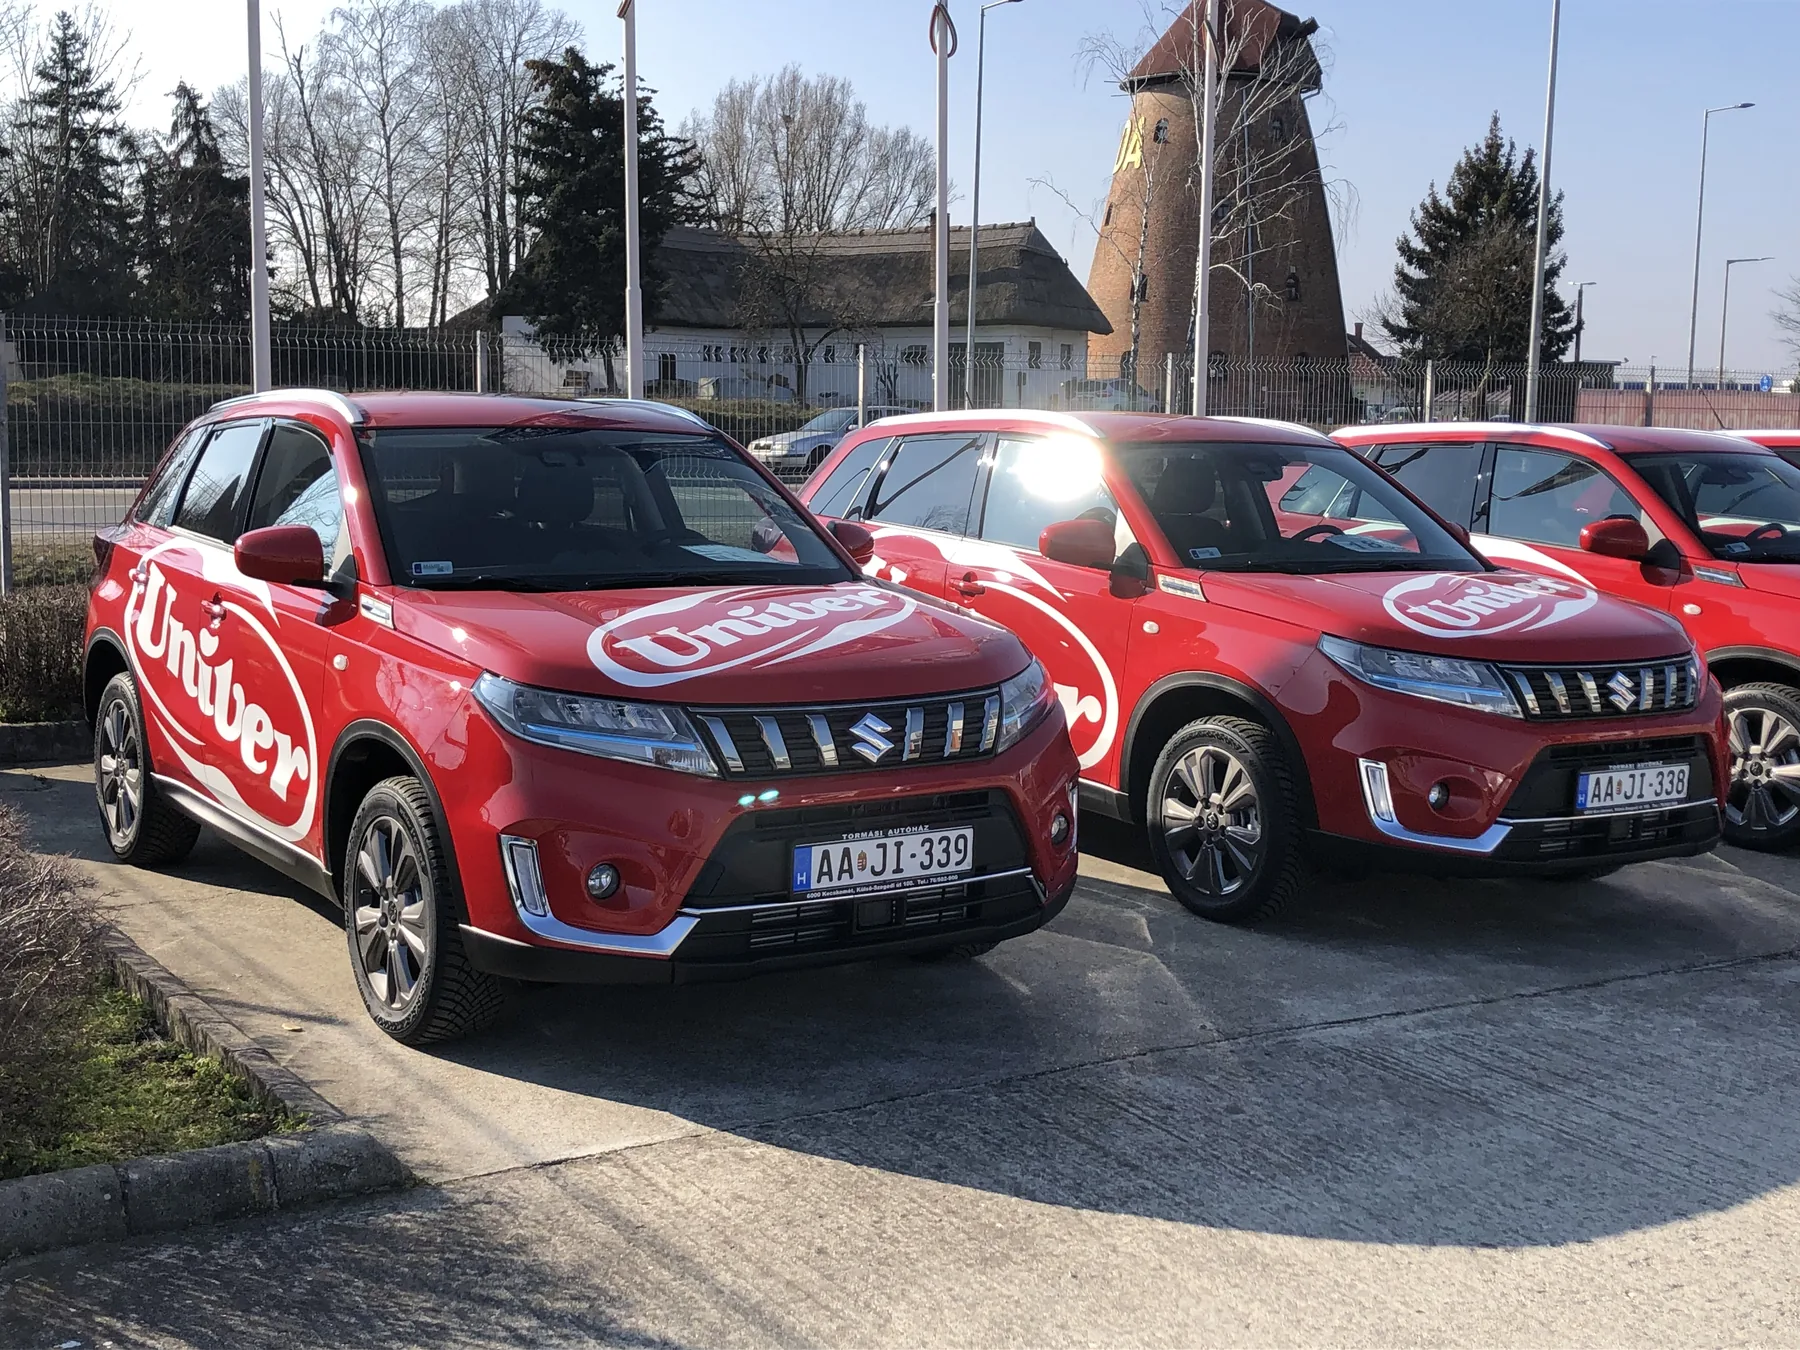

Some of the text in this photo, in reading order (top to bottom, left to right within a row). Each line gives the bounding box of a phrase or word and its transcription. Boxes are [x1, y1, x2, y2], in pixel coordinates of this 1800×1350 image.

[1405, 577, 1571, 627] Univer
[612, 590, 893, 667] Univer
[131, 560, 309, 802] Univer
[1578, 793, 1586, 804] H
[842, 824, 930, 840] TORMÁSI AUTÓHÁZ
[797, 872, 807, 885] H
